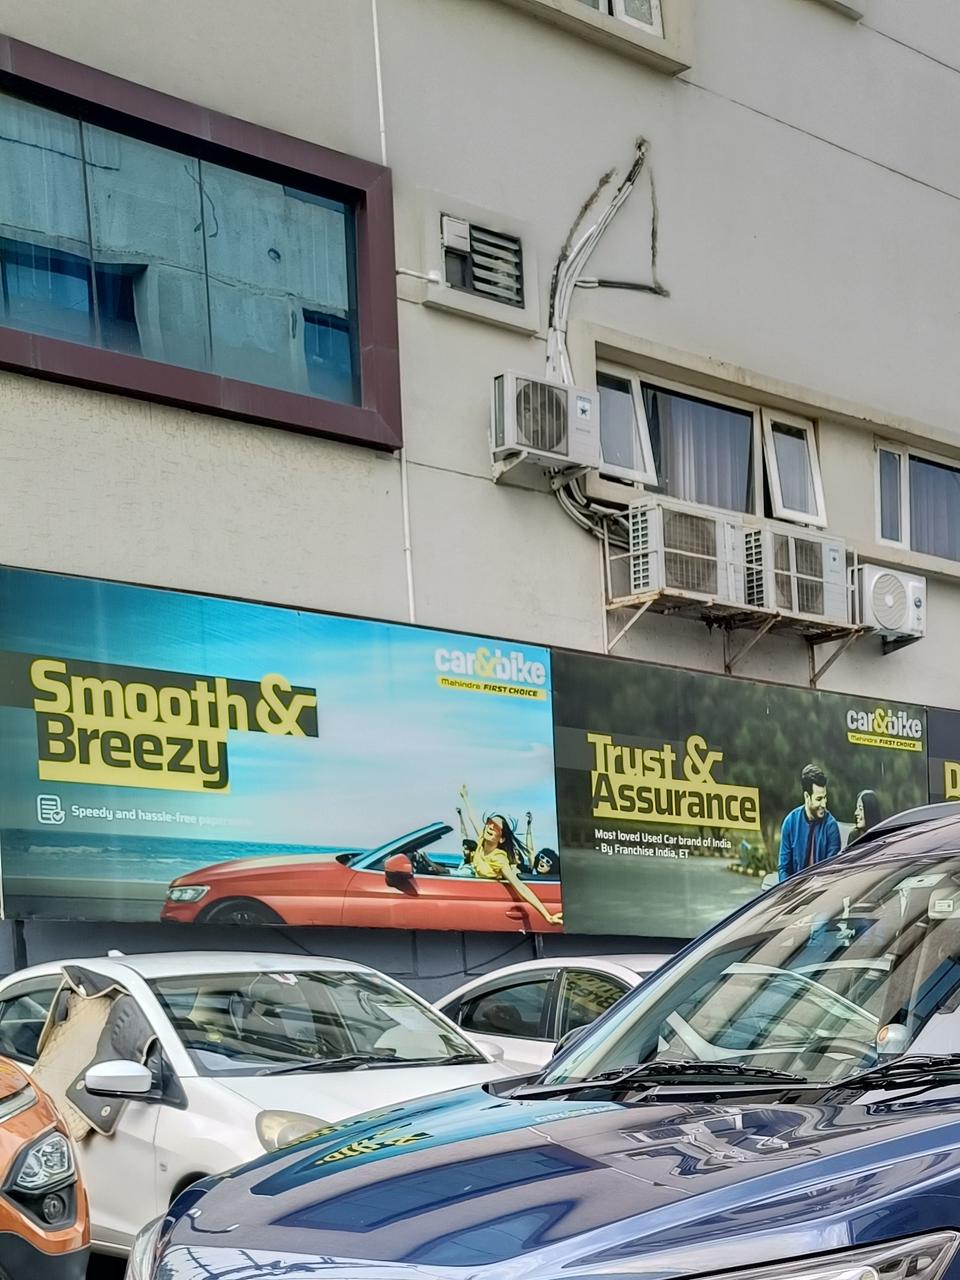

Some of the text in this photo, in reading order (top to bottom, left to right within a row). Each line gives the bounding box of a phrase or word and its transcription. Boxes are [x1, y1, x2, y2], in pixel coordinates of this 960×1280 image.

[435, 647, 546, 685] car&bike
[30, 659, 317, 737] Smooth &
[441, 678, 538, 698] Mahindra FIRST CHOICE
[846, 708, 922, 738] car&bike
[38, 711, 229, 789] Breezy
[587, 732, 723, 784] Trust &
[879, 739, 896, 747] FIRST
[896, 741, 916, 749] CHOICE
[593, 773, 757, 823] Assurance
[71, 805, 113, 820] Speedy
[115, 808, 137, 820] and
[138, 809, 197, 824] hassle-free
[594, 829, 732, 849] Most loved Used Car brand of India
[601, 843, 613, 855] By
[614, 844, 654, 857] Franchise
[655, 847, 678, 859] India,
[679, 849, 690, 859] ET
